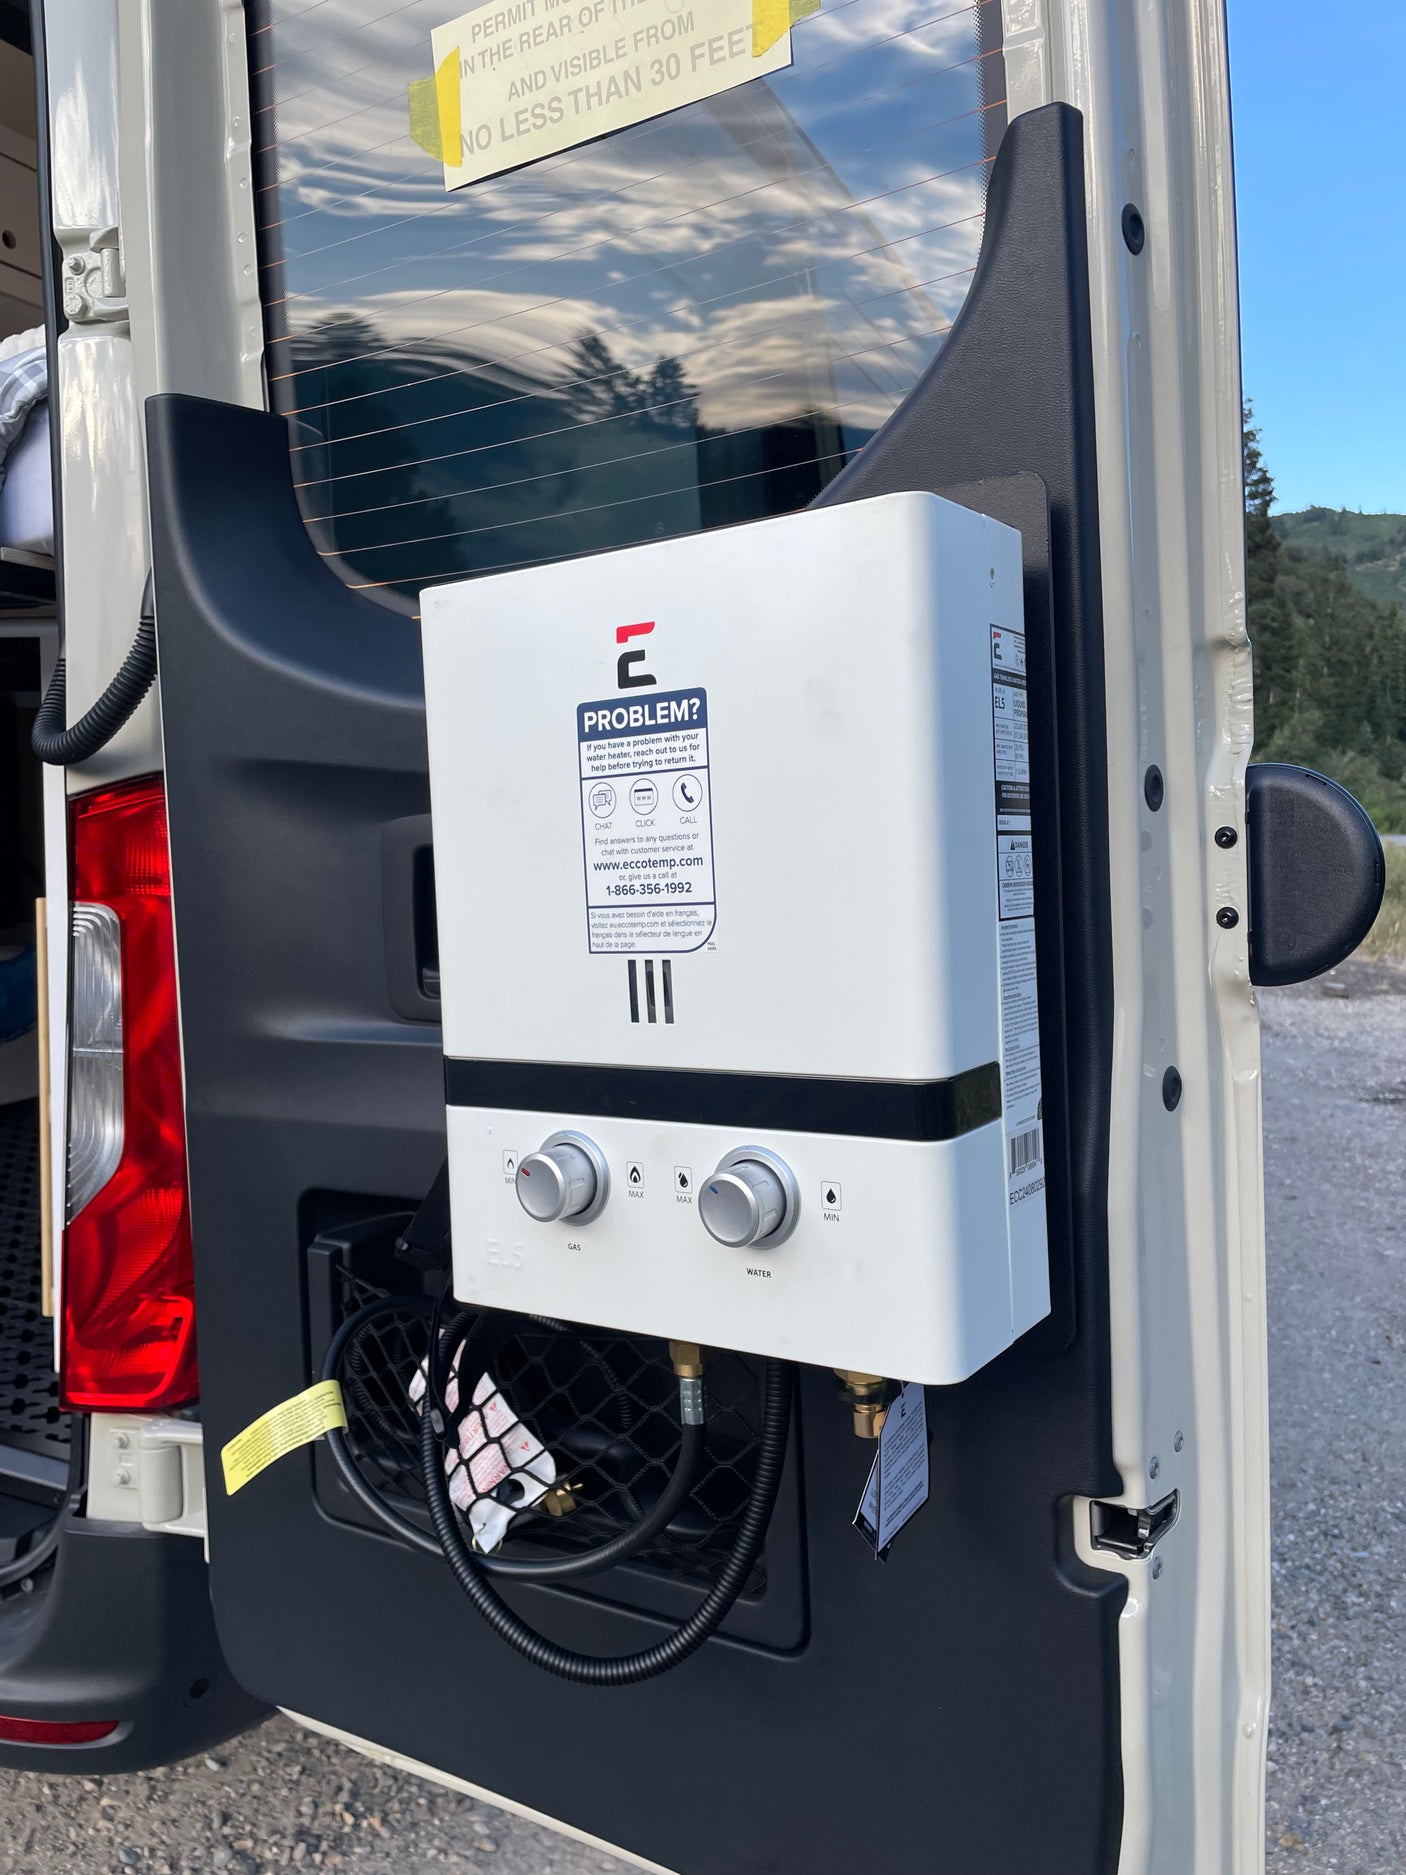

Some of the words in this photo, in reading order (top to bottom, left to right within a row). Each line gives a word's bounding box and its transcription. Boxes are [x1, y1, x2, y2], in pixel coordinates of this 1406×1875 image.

[471, 0, 536, 43] PERMIT
[459, 55, 476, 79] IN
[478, 38, 514, 68] THE
[519, 15, 572, 52] REAR
[578, 1, 605, 28] OF
[508, 69, 547, 101] AND
[550, 37, 628, 83] VISIBLE
[633, 11, 695, 52] FROM
[460, 123, 492, 158] NO
[499, 96, 564, 142] LESS
[567, 65, 642, 115] THAN
[650, 52, 681, 87] 30
[583, 697, 701, 733] PROBLEM?
[586, 743, 592, 751] If
[593, 743, 606, 752] you
[608, 741, 625, 749] have
[632, 737, 662, 748] problem
[663, 733, 680, 742] with
[681, 732, 699, 743] your
[586, 754, 606, 762] water
[608, 751, 632, 760] heater,
[633, 748, 654, 757] reach
[655, 747, 668, 755] out
[689, 743, 700, 751] for
[591, 764, 606, 773] help
[608, 761, 631, 771] before
[632, 759, 653, 770] trying
[664, 756, 687, 765] return
[688, 753, 696, 762] it.
[594, 822, 613, 831] CHAT
[635, 819, 656, 828] CLICK
[679, 816, 698, 825] CALL
[594, 837, 609, 846] Find
[609, 836, 636, 845] answers
[637, 835, 644, 843] to
[645, 835, 657, 844] any
[658, 832, 691, 843] questions
[691, 832, 699, 840] or
[1014, 841, 1029, 849] DANGER
[601, 847, 615, 856] chat
[615, 846, 630, 855] with
[630, 845, 660, 855] customer
[661, 843, 686, 852] service
[686, 843, 694, 851] at
[593, 856, 703, 871] www.eccotemp.com
[628, 872, 642, 883] give
[657, 871, 670, 879] call
[670, 871, 678, 879] at
[605, 881, 693, 896] 1-866-356-1992
[505, 1176, 517, 1184] MIN
[628, 1190, 644, 1199] MAX
[676, 1195, 693, 1205] MAX
[823, 1213, 840, 1222] MIN
[567, 1242, 581, 1251] GAS
[746, 1267, 772, 1278] WATER
